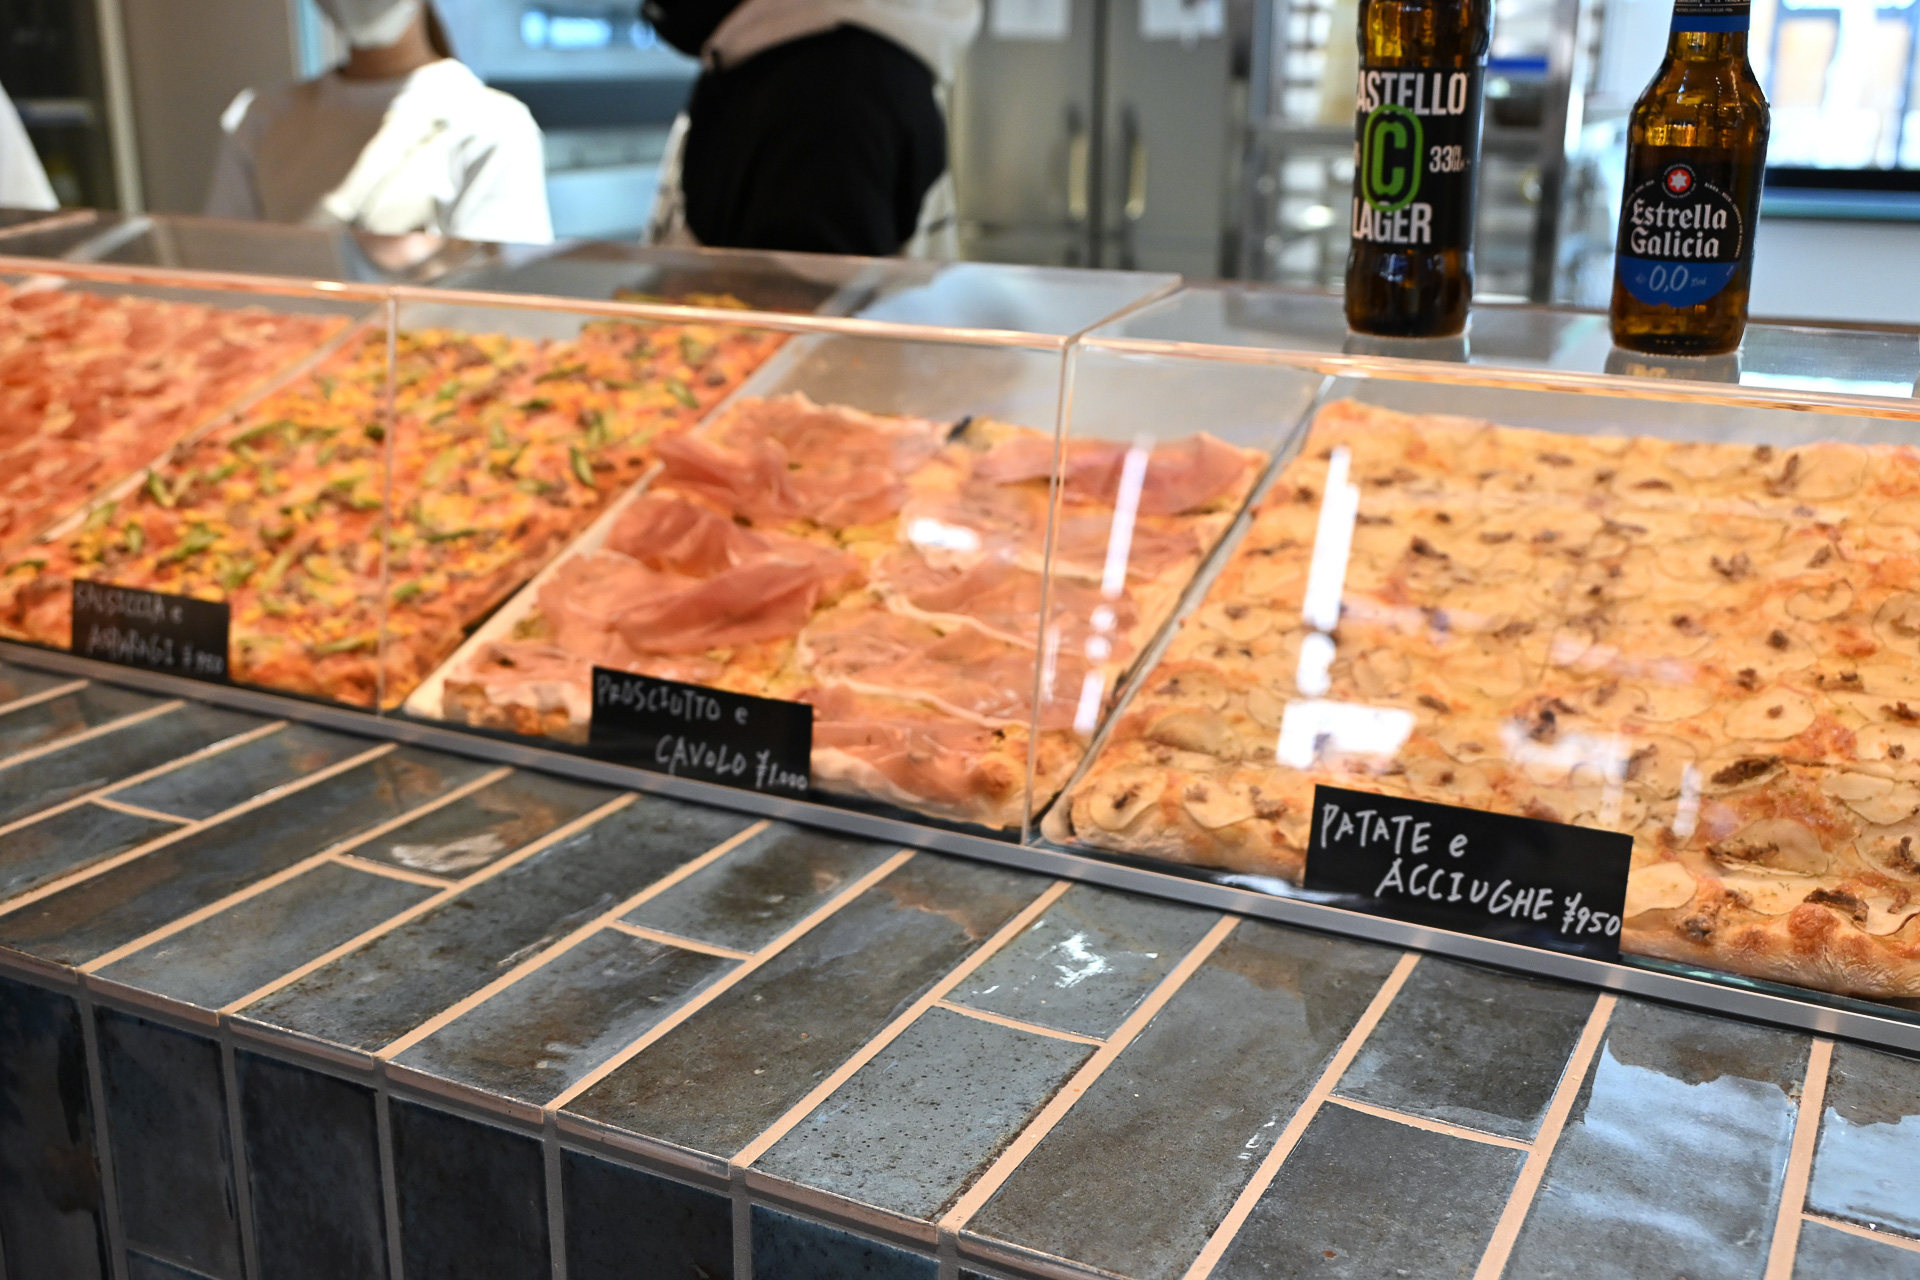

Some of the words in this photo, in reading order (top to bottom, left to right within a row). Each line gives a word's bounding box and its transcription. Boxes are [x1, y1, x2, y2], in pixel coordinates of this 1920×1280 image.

[1356, 70, 1469, 115] ASTELLO
[1371, 120, 1408, 196] C
[1353, 197, 1433, 244] LAGER
[1630, 198, 1728, 230] Estrella
[1631, 226, 1720, 258] Galicia
[597, 674, 721, 722] PROSCIUTTO
[734, 706, 748, 725] e
[655, 735, 747, 776] CAVOLO
[1320, 803, 1432, 856] PATATE
[1449, 834, 1468, 857] e
[1374, 858, 1553, 921] ACCIUGHE
[1560, 892, 1621, 936] ¥950
